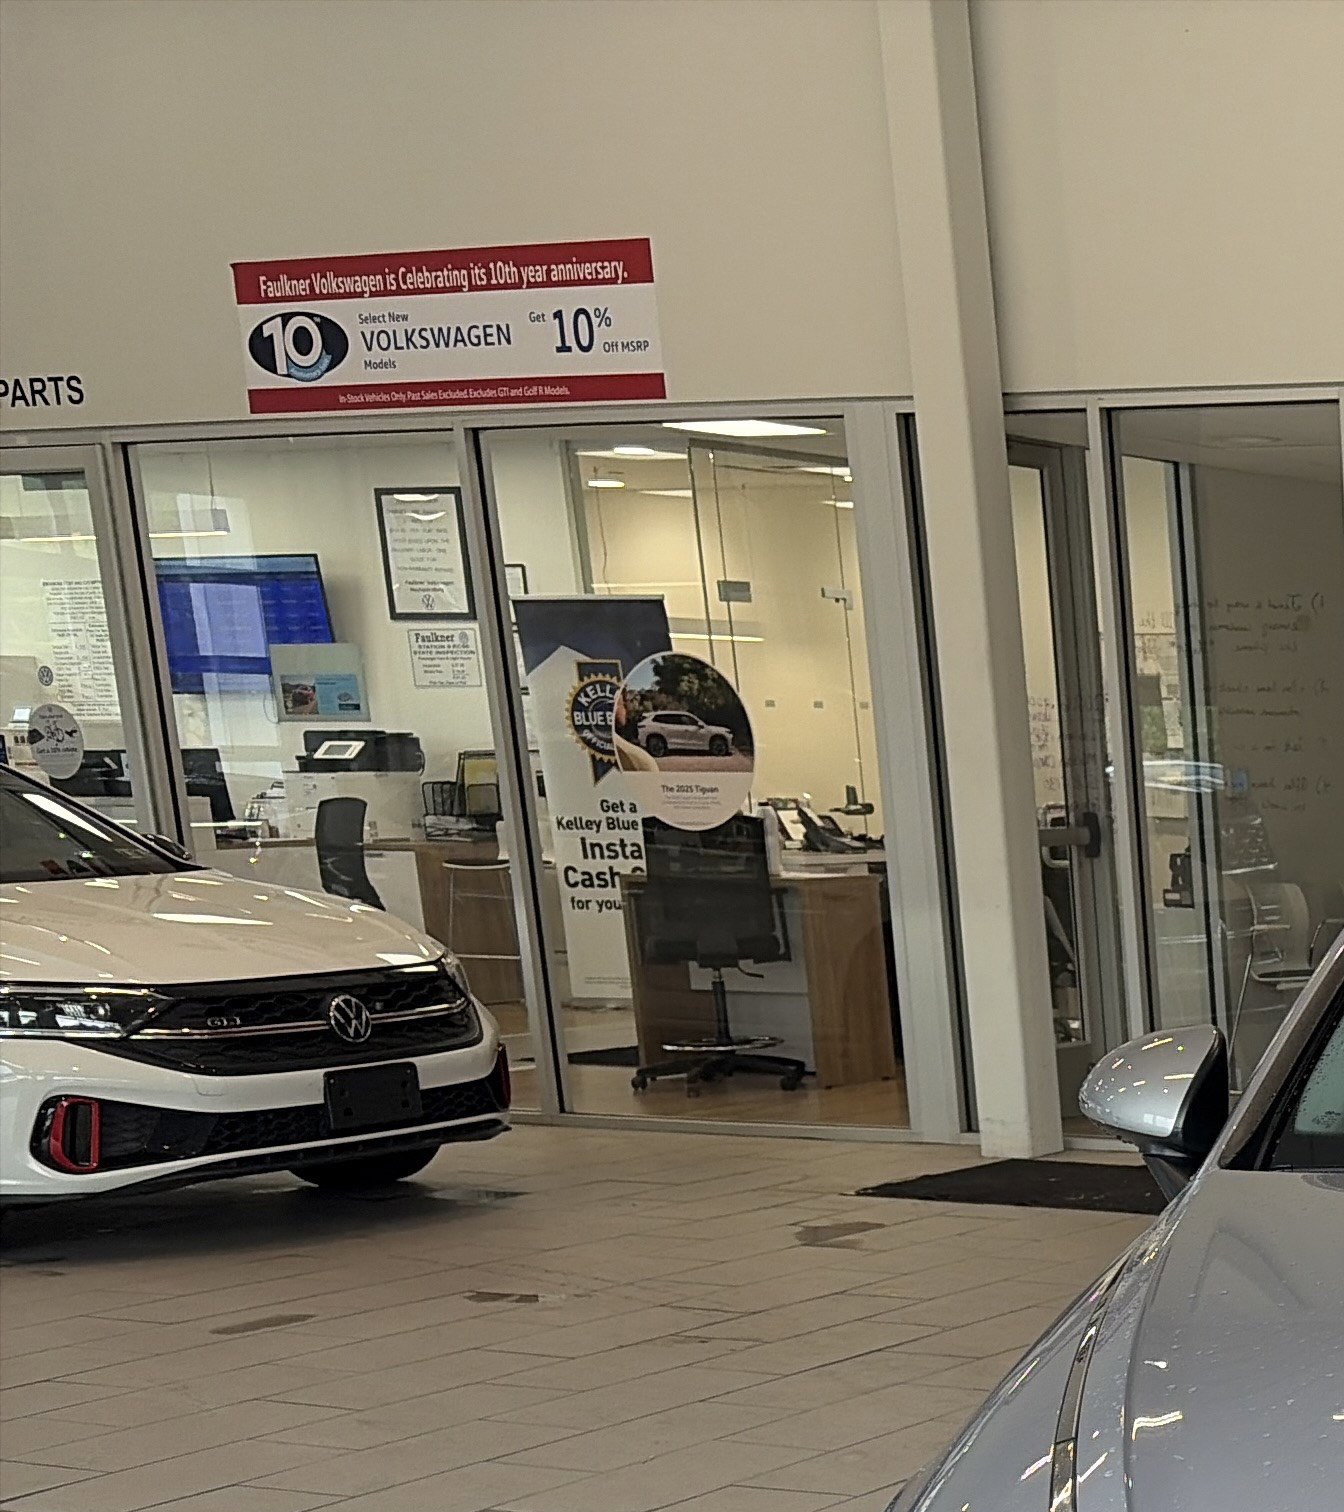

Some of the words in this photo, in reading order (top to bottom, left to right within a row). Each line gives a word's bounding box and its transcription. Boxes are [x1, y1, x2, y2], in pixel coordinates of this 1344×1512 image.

[259, 274, 311, 298] Faulkner
[311, 271, 384, 298] Volkswagen
[384, 268, 397, 290] is
[399, 263, 469, 291] Celebrating
[489, 261, 518, 284] 10th
[520, 263, 549, 289] year
[551, 257, 628, 284] anniversary.
[358, 313, 387, 325] Select
[388, 311, 409, 323] New
[528, 311, 546, 323] Get
[360, 323, 513, 352] VOLKSWAGEN
[262, 315, 323, 375] 10
[603, 340, 619, 353] Off
[621, 340, 649, 352] MSRP
[363, 358, 397, 371] Models
[422, 390, 438, 400] Sales
[415, 632, 455, 643] Faulkner
[577, 683, 615, 707] KELL
[573, 711, 606, 726] BLUE
[661, 784, 675, 793] The
[694, 784, 720, 795] Tiguan
[600, 799, 626, 813] Get
[629, 802, 638, 813] a
[556, 816, 603, 834] Kelley
[605, 816, 639, 831] Blue
[580, 836, 643, 860] Insta
[570, 896, 592, 910] for
[596, 899, 623, 914] you
